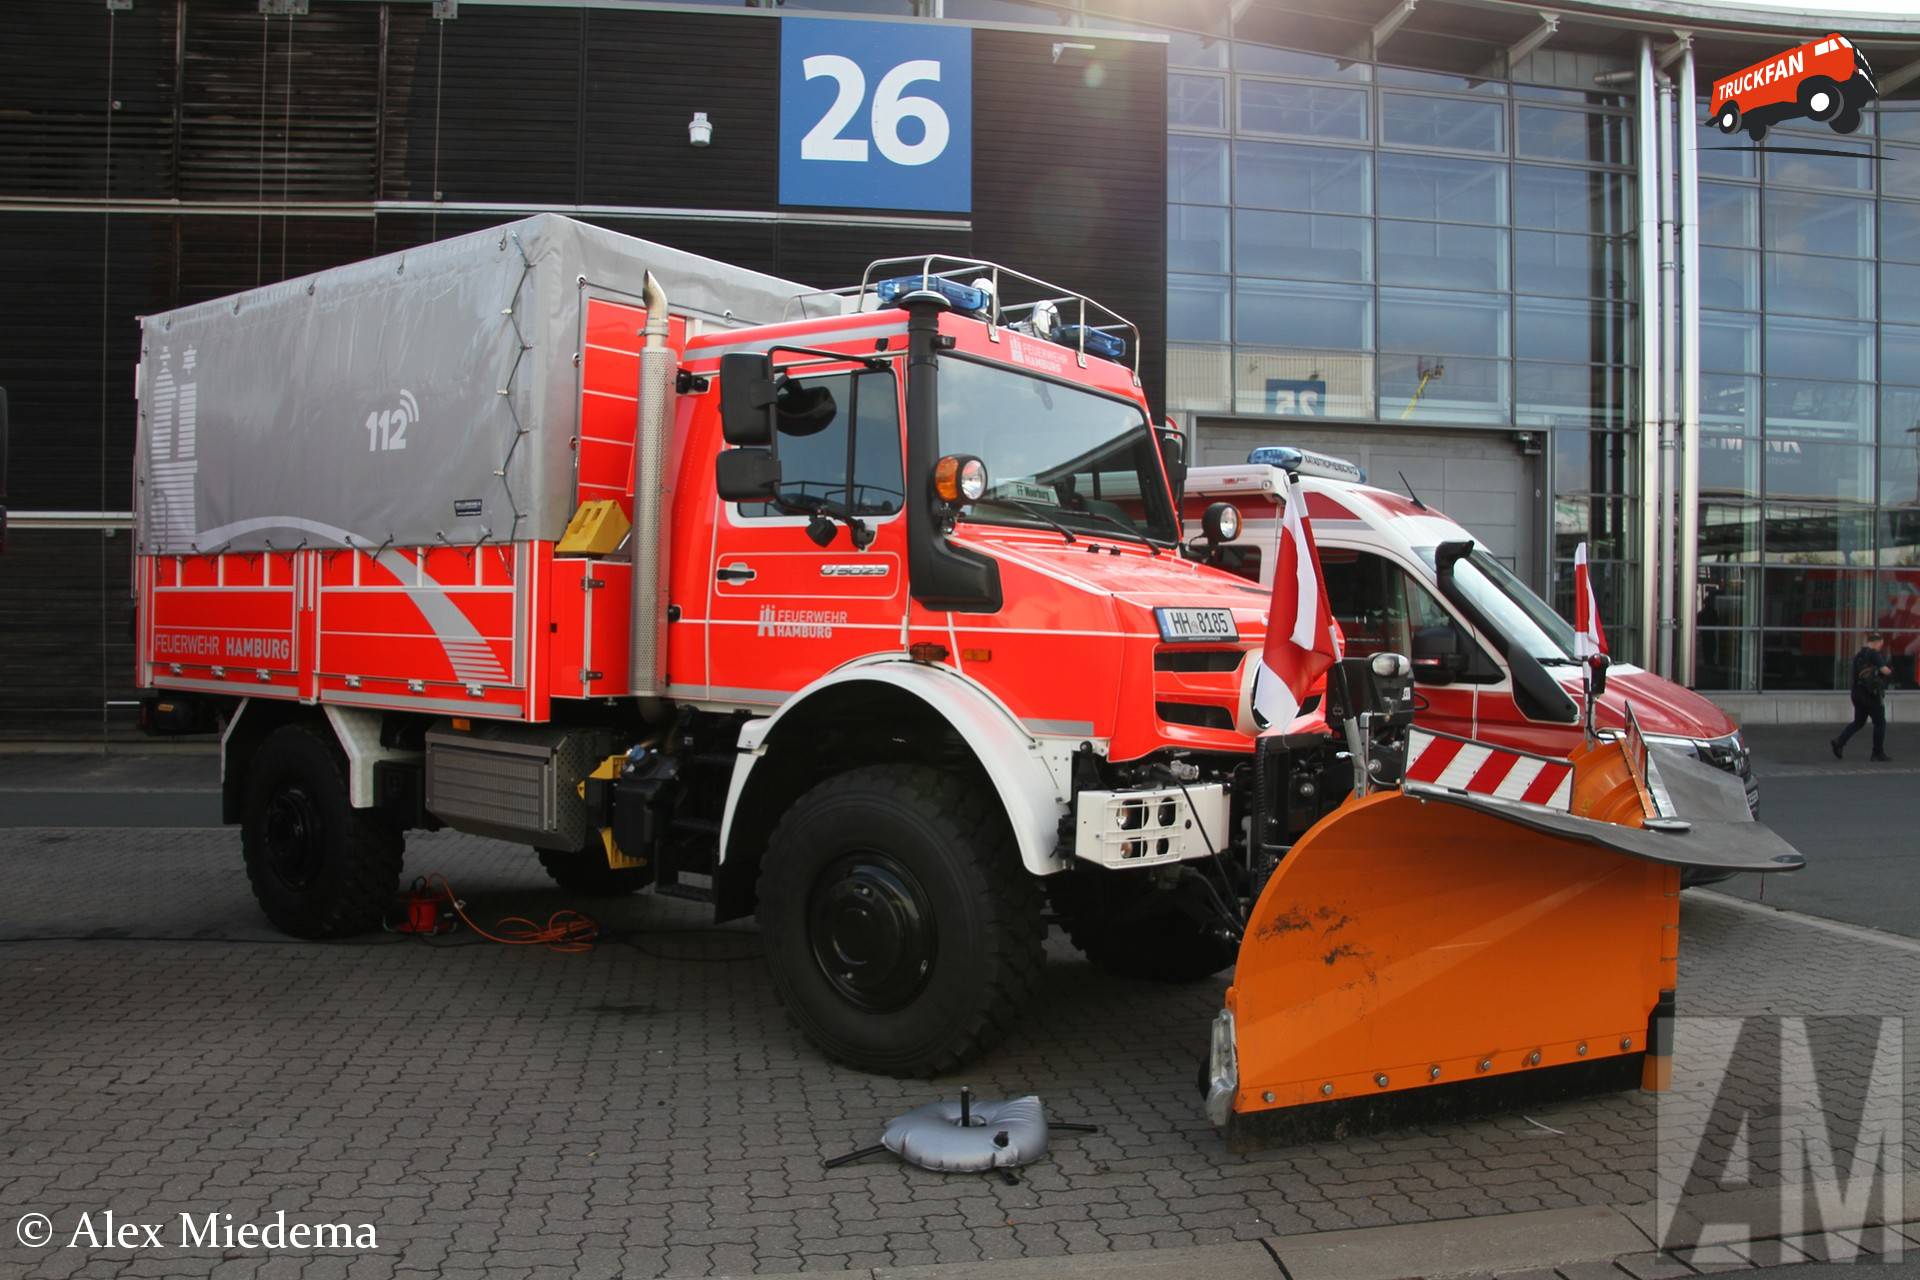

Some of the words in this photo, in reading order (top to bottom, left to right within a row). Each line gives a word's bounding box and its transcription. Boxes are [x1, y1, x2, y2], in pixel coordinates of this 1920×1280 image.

[801, 54, 950, 166] 26
[365, 408, 408, 452] 112
[777, 609, 848, 625] FEUERWEHR
[1170, 612, 1193, 634] HH
[1196, 612, 1229, 633] 8185
[777, 622, 833, 639] HAMBURG
[154, 633, 221, 656] FEUERWEHR
[226, 637, 289, 660] HAMBURG
